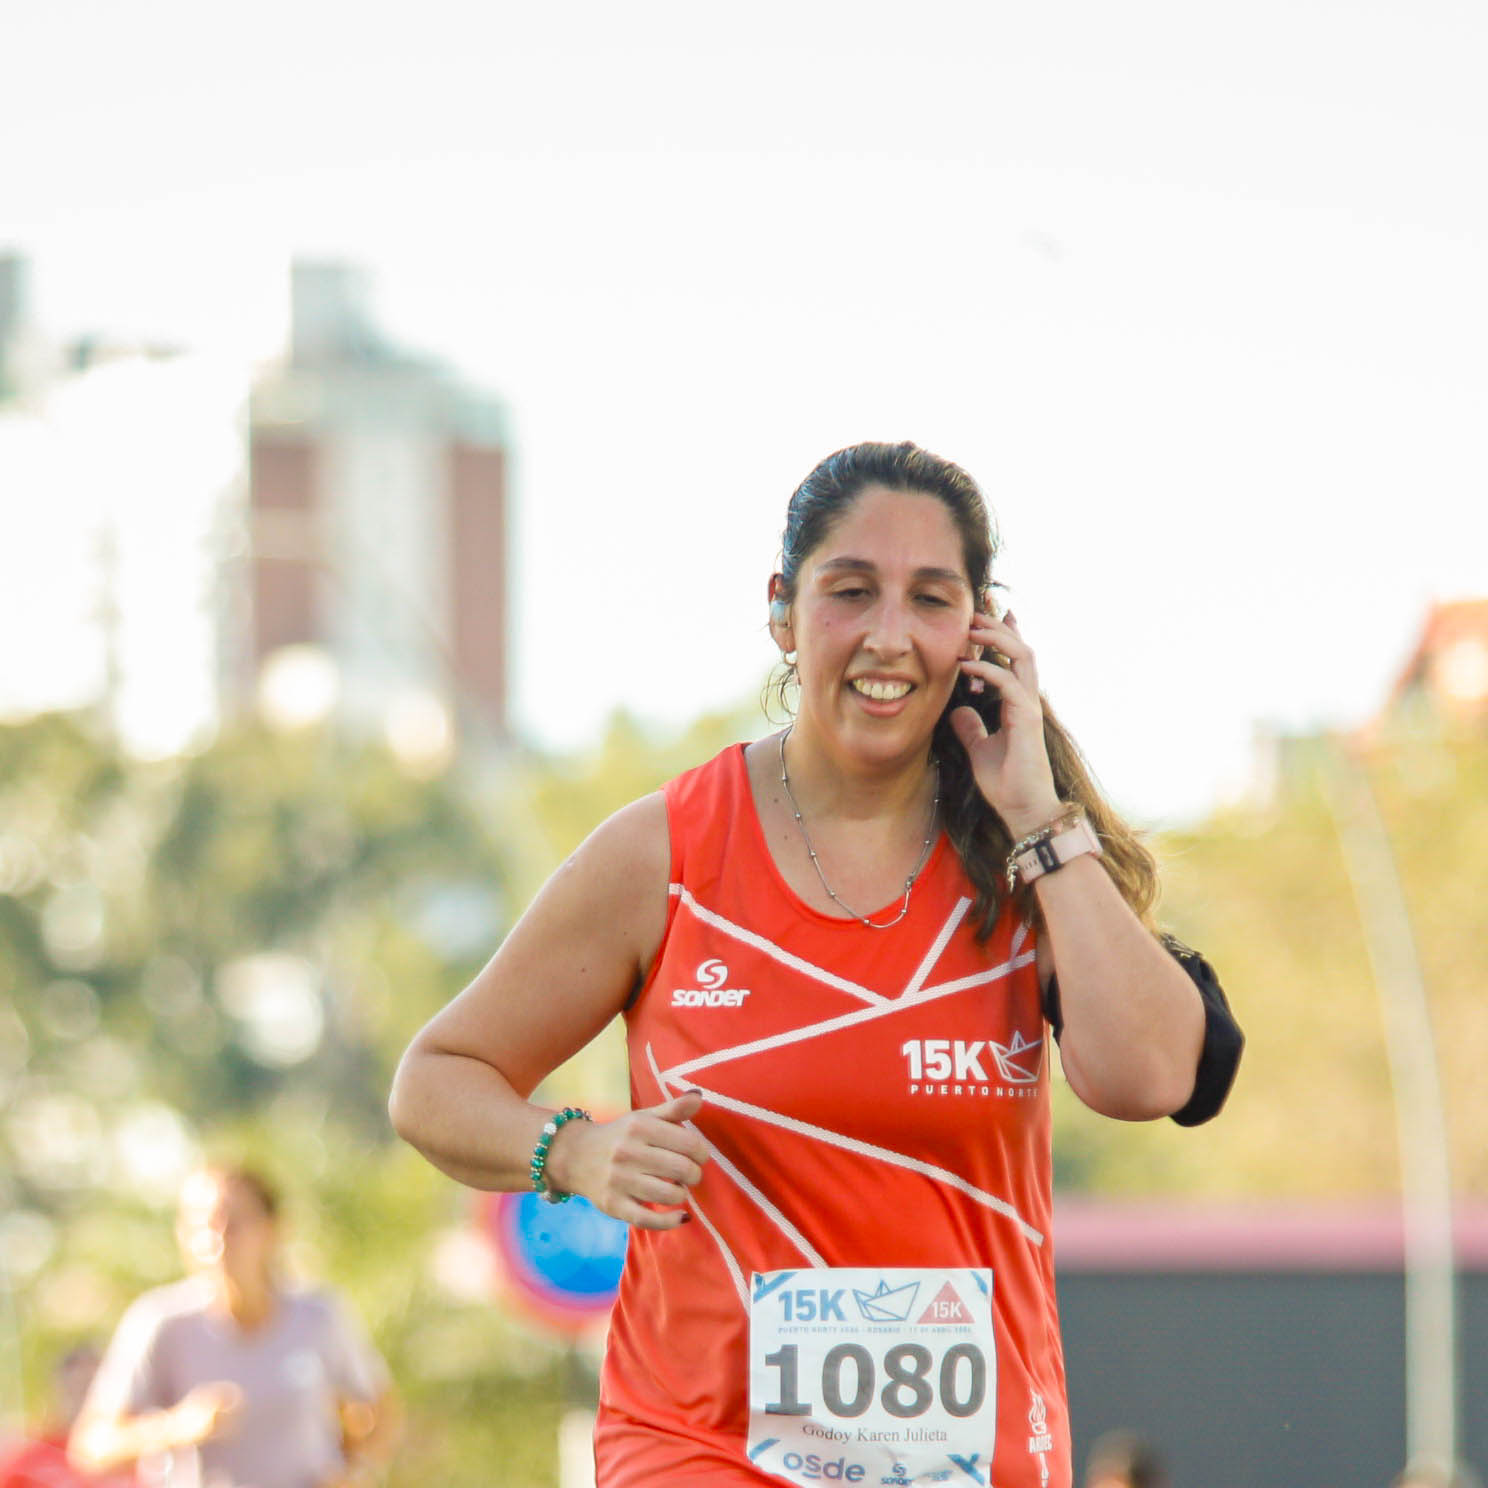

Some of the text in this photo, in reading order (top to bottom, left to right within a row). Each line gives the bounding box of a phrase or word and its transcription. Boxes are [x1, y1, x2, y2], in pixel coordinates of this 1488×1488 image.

[902, 1040, 989, 1080] 15K
[911, 1084, 1040, 1097] PUERTO NORTE
[778, 1289, 962, 1321] 15K 15K
[765, 1343, 987, 1419] 1080
[802, 1423, 948, 1444] Godoy Karen Julieta
[783, 1452, 866, 1483] osde
